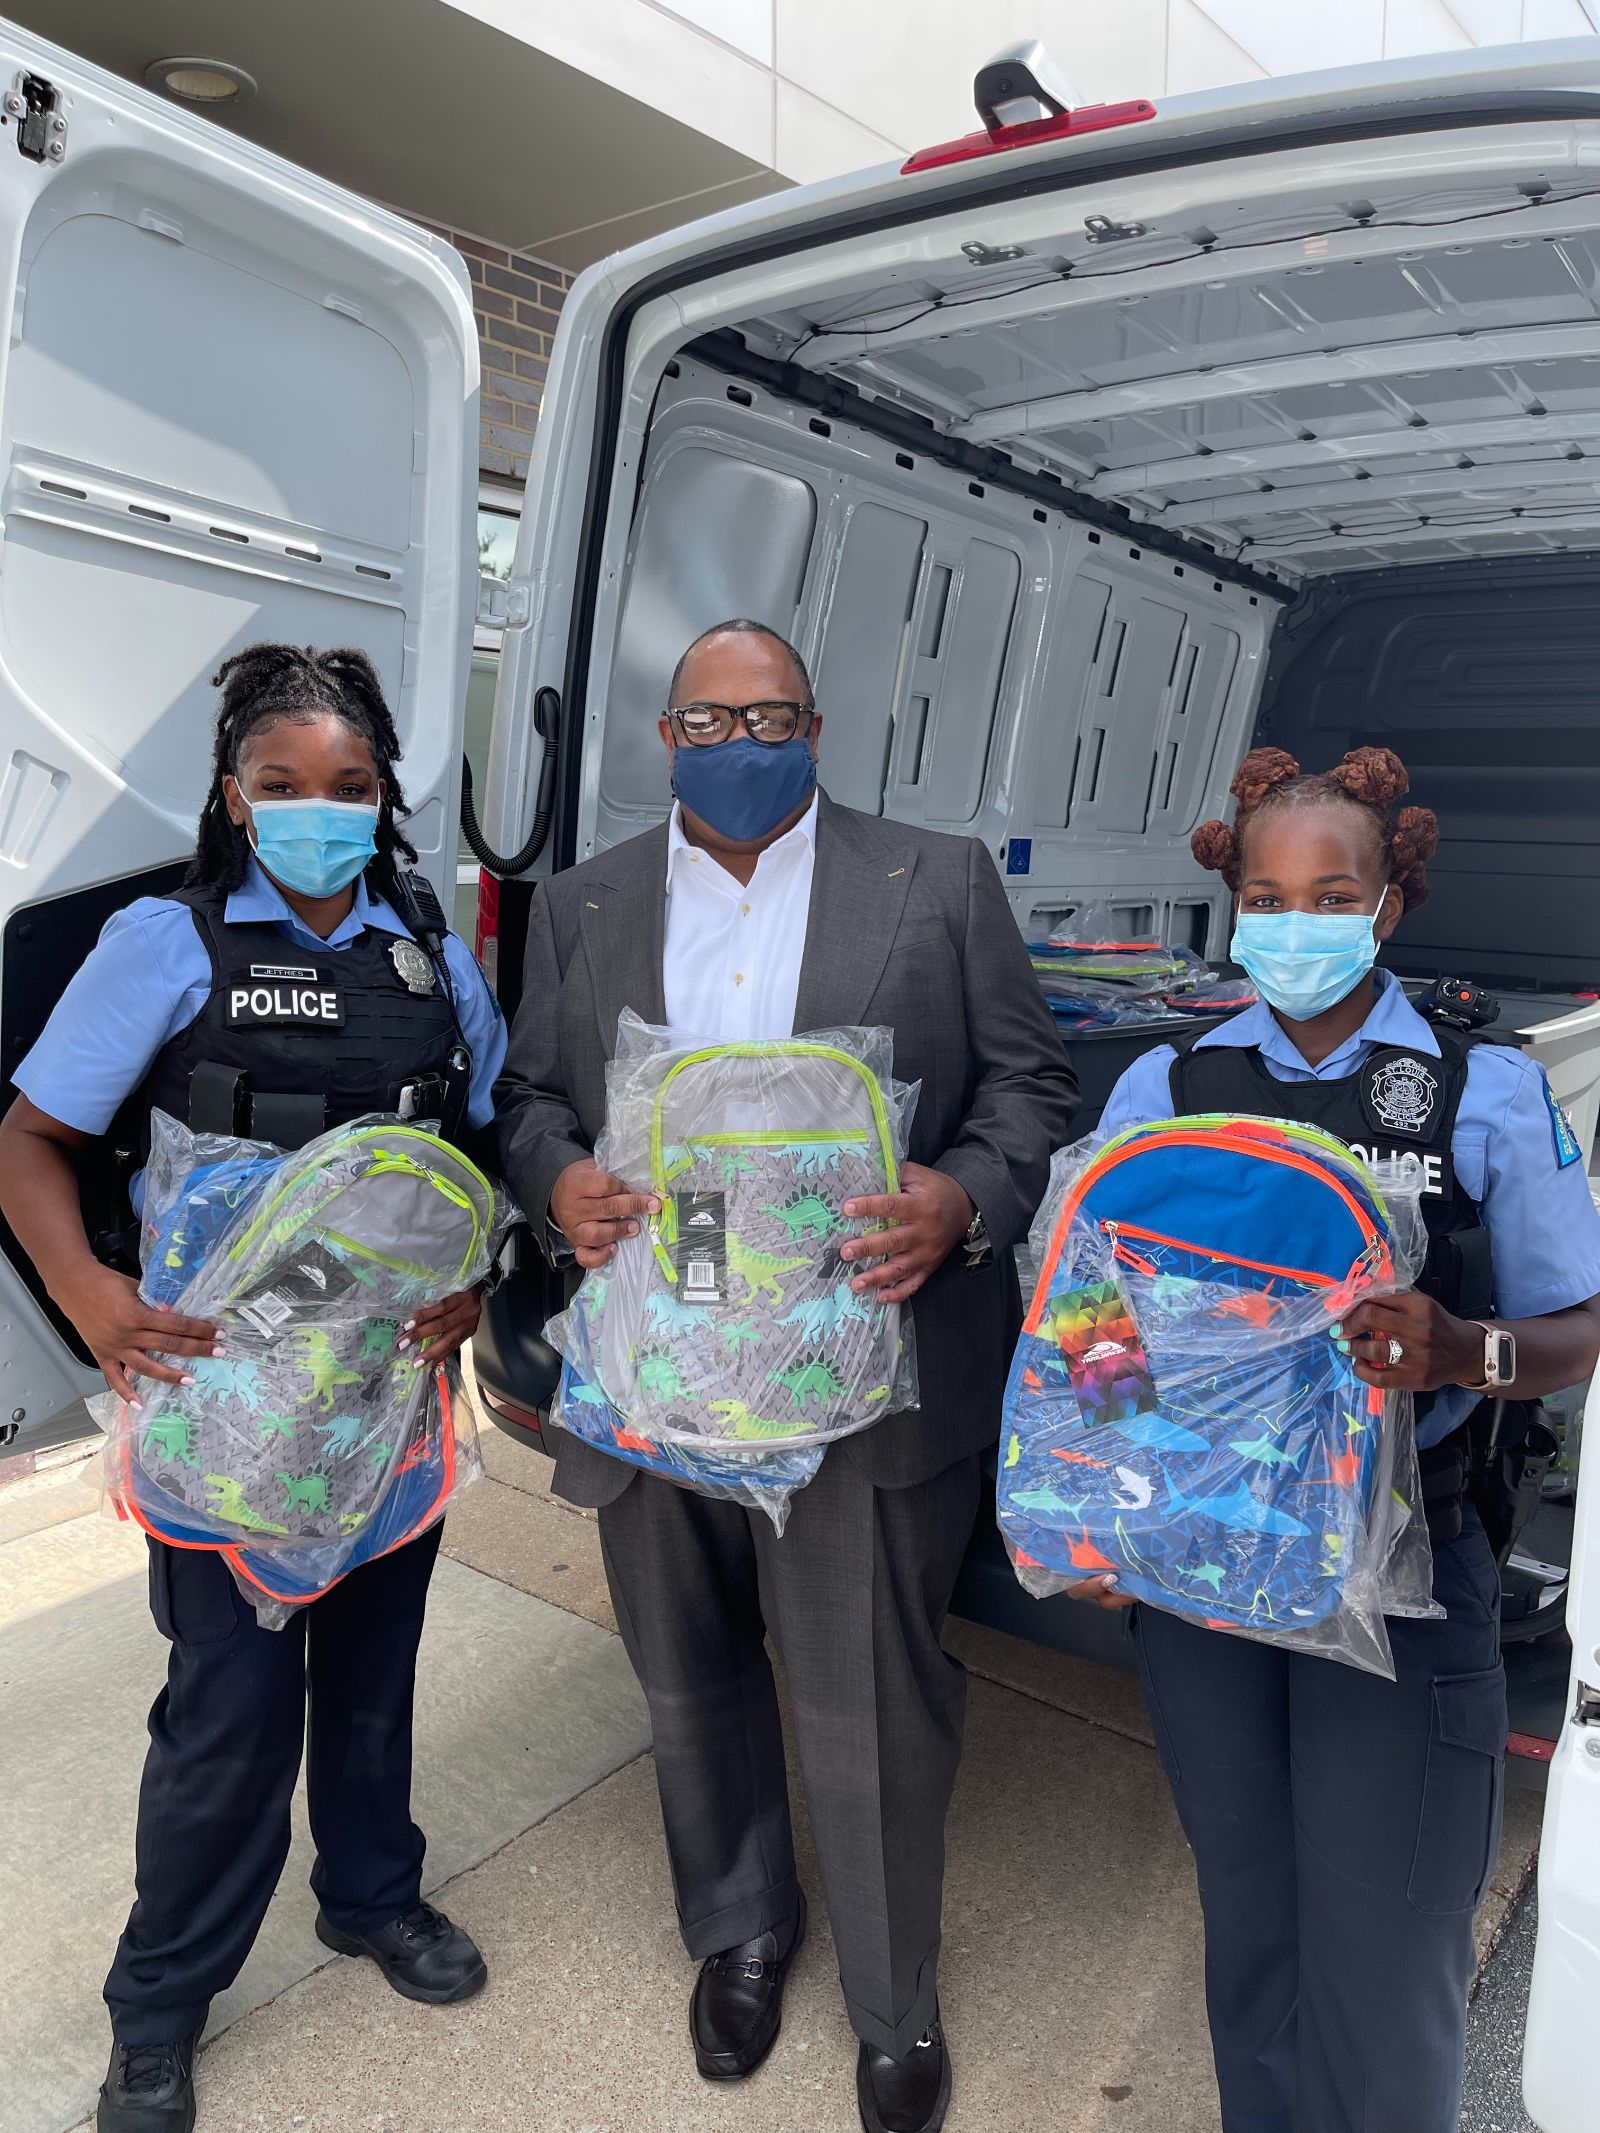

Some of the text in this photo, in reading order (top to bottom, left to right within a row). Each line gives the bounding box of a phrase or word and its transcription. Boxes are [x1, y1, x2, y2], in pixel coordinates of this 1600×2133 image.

[231, 988, 339, 1019] POLICE
[1399, 1067, 1425, 1079] LOUIS
[1385, 1110, 1417, 1120] POLICE
[1393, 1120, 1409, 1129] 492
[1348, 1143, 1443, 1195] OLICE
[1081, 1346, 1128, 1365] TRAILMAKER
